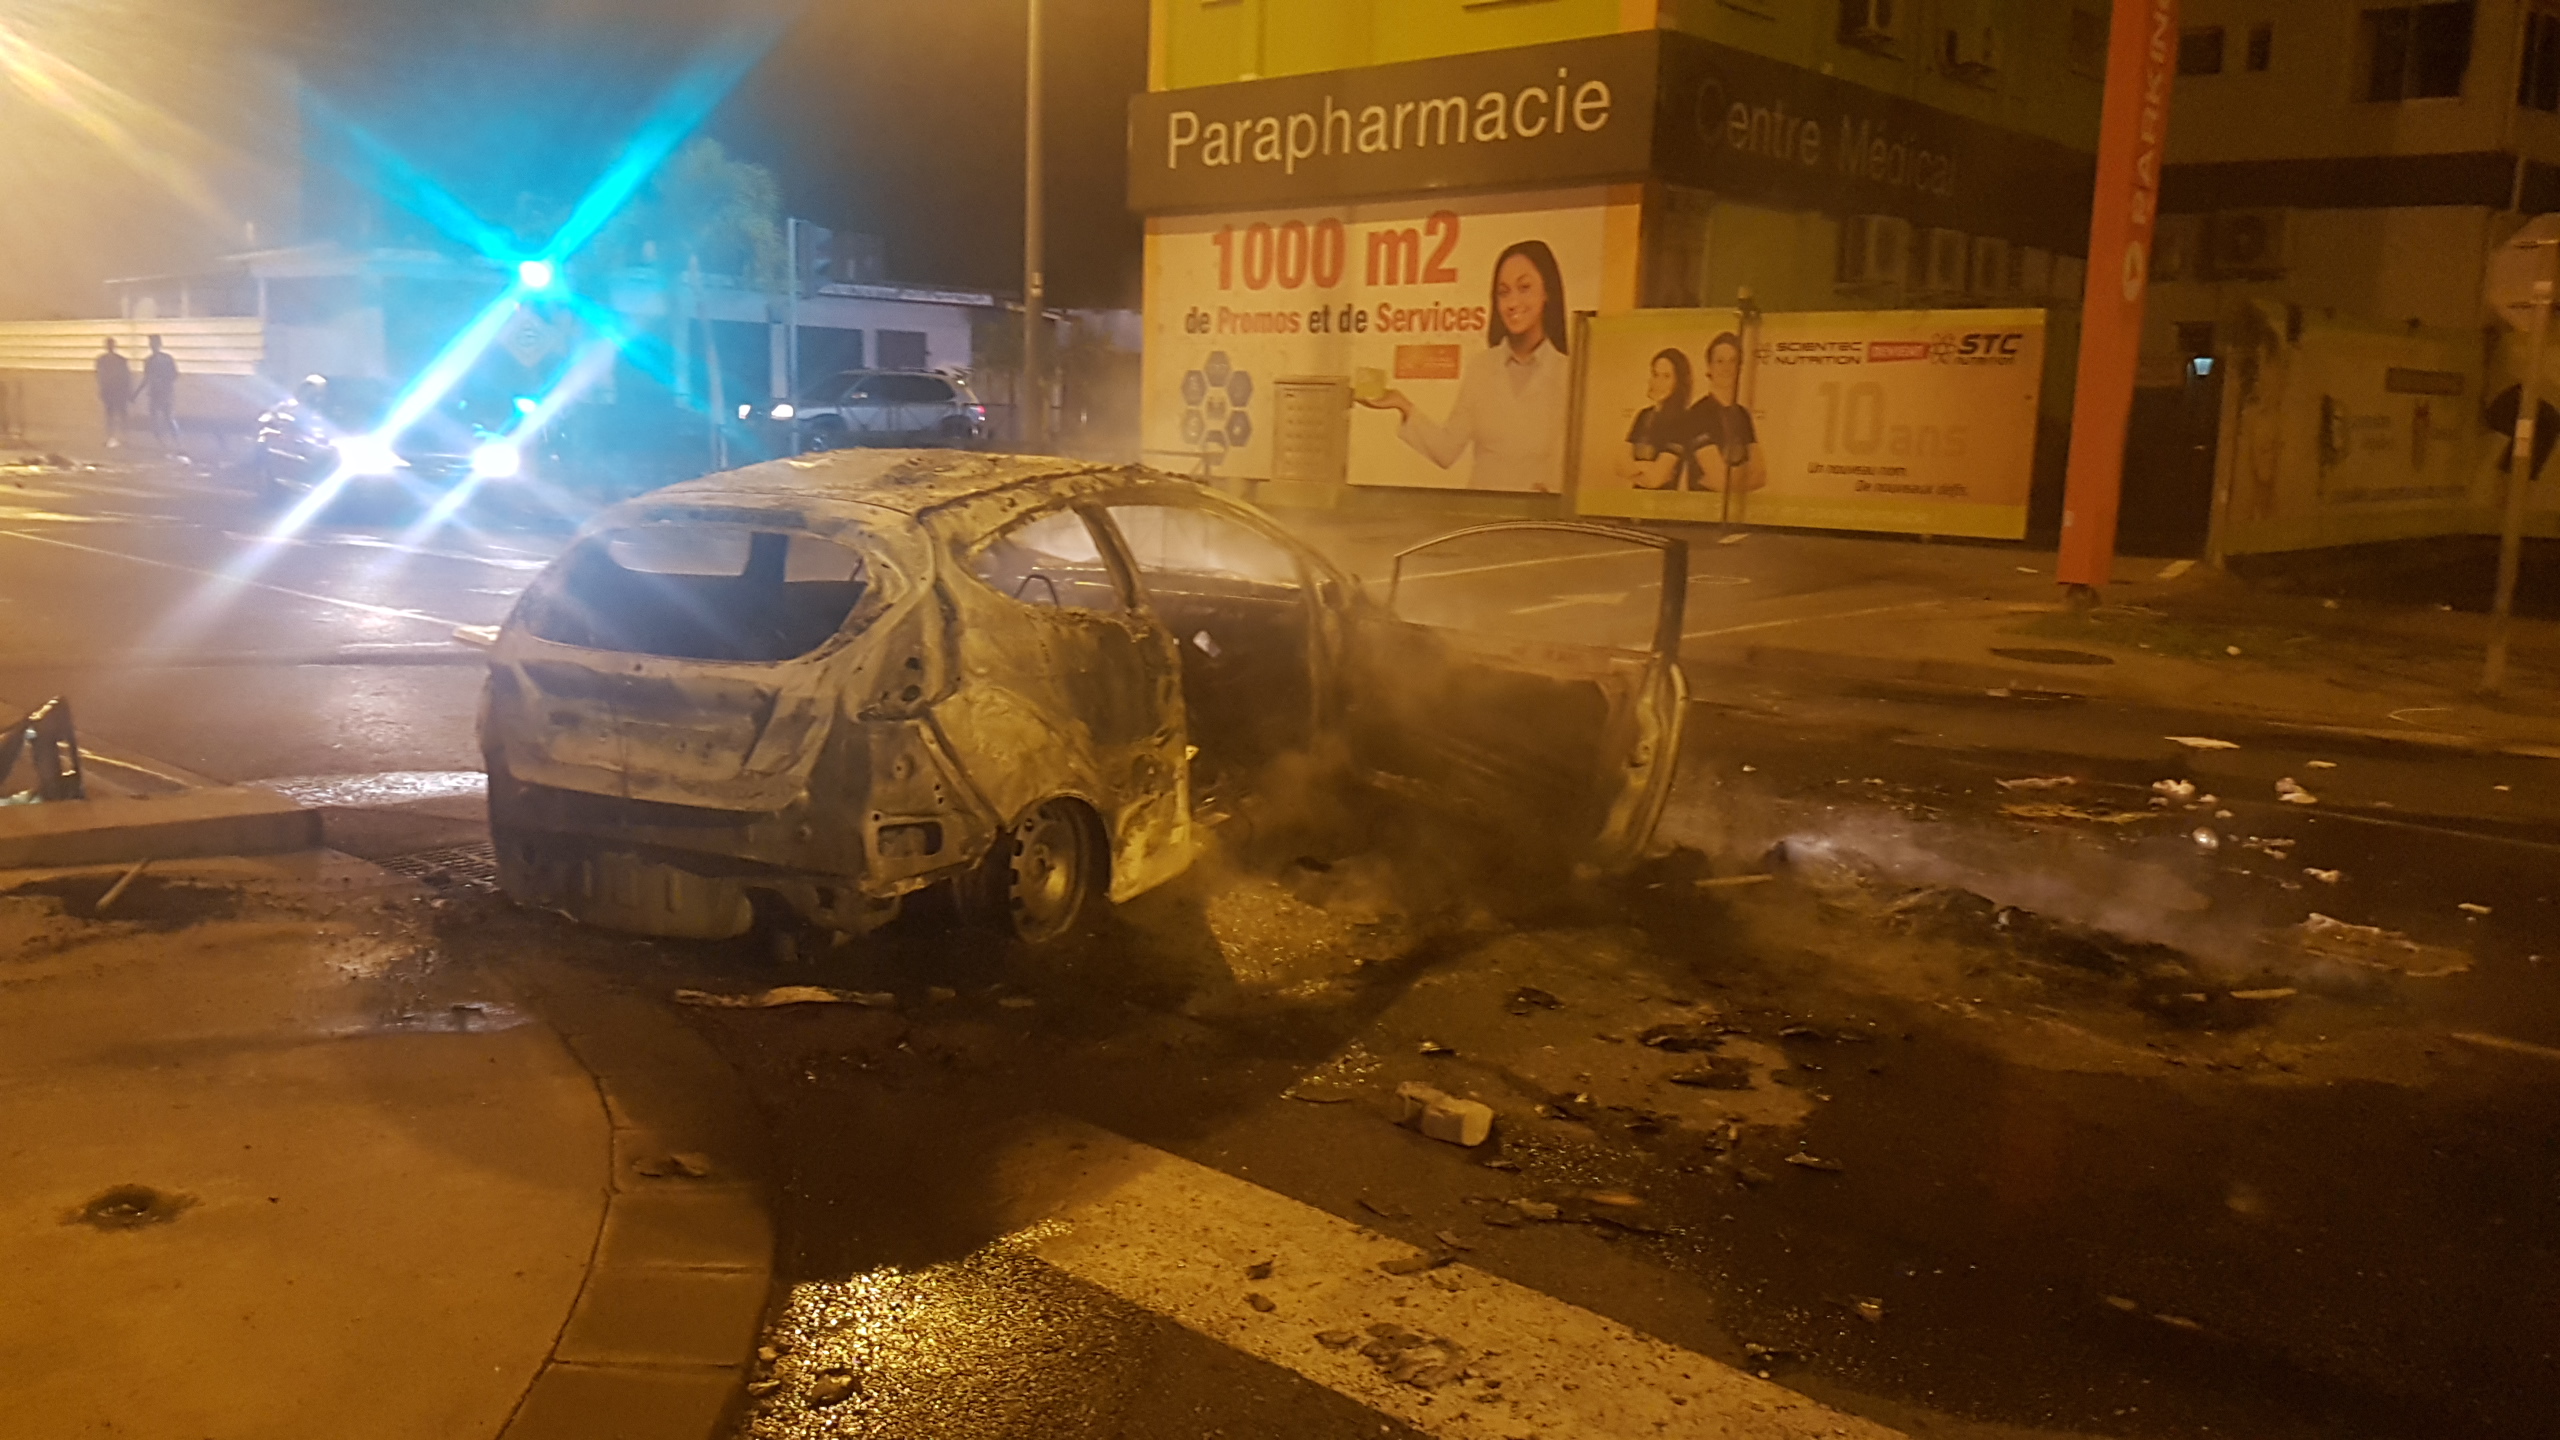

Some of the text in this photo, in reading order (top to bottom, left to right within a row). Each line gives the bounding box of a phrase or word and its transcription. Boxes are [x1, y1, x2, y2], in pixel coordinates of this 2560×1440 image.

[1168, 67, 1612, 174] Parapharmacie
[1696, 77, 1821, 166] Centre
[1212, 209, 1460, 291] 1000 m2
[1186, 300, 1486, 335] de Promos et de Services
[1957, 333, 2023, 355] STC
[1776, 342, 1862, 353] SCIENTEC
[1776, 355, 1861, 366] NUTRITION
[1816, 381, 1971, 459] 10 ans
